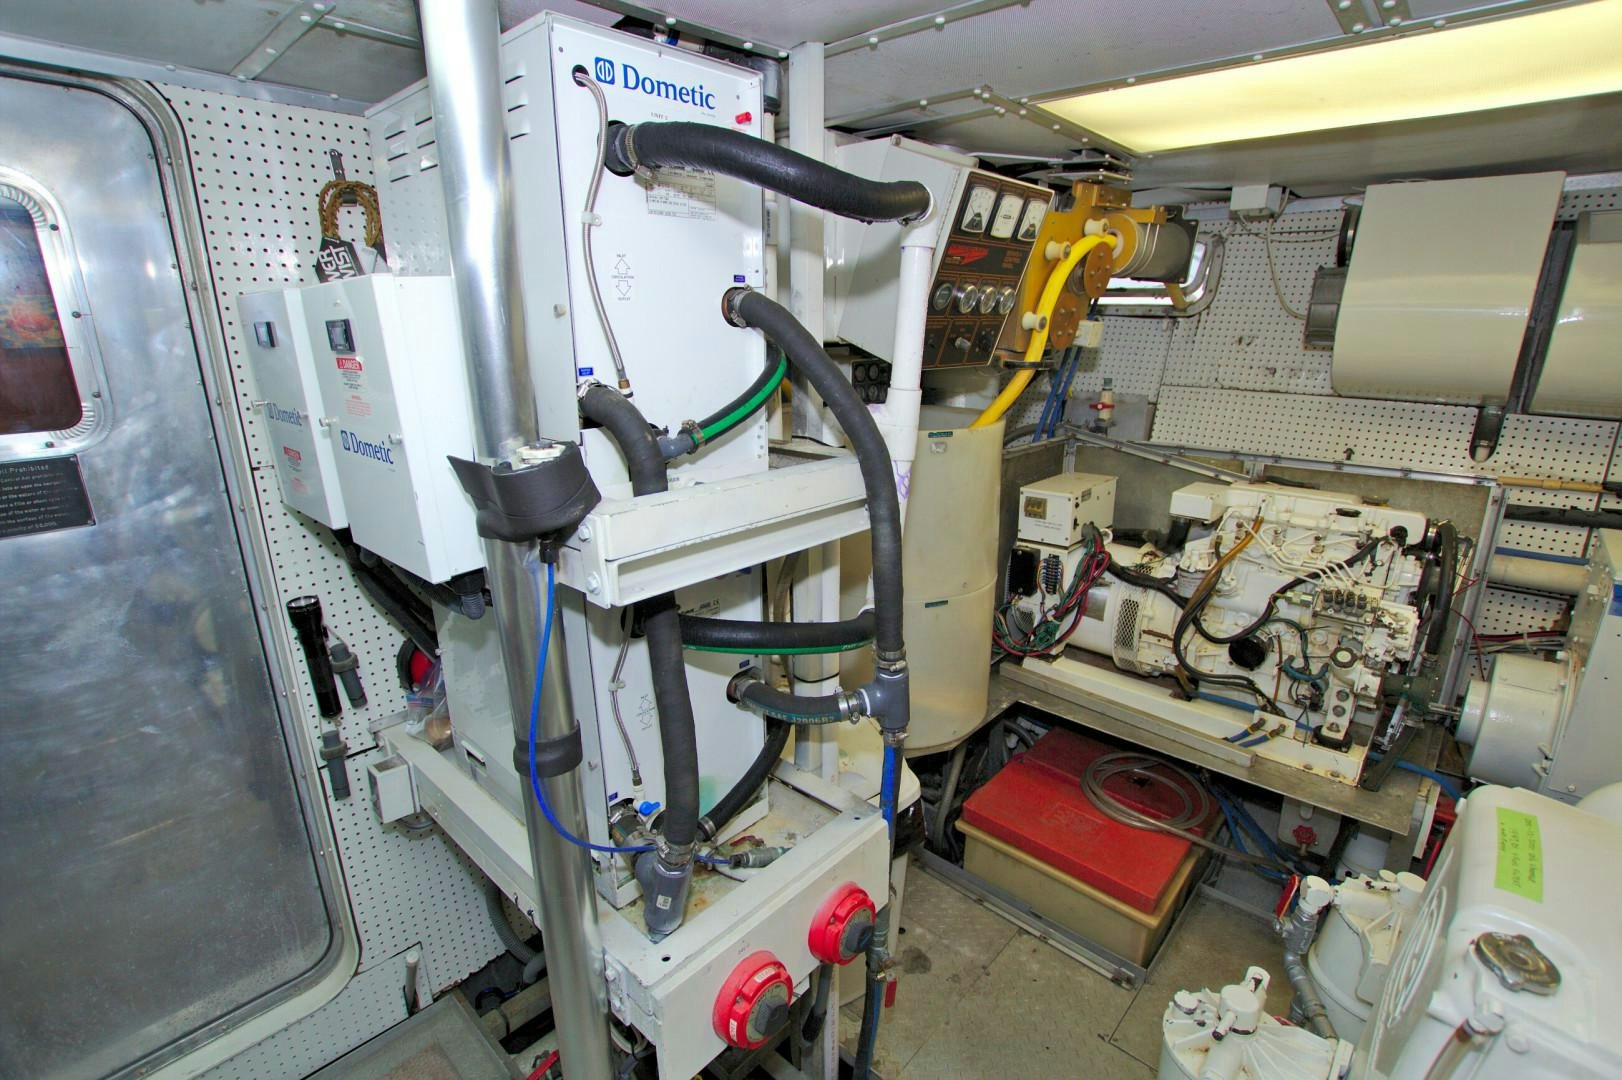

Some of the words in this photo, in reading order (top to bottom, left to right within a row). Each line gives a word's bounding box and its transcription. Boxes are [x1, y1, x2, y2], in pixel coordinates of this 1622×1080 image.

[622, 63, 716, 110] Dometic
[273, 403, 303, 426] Dometic
[349, 432, 394, 465] Dometic
